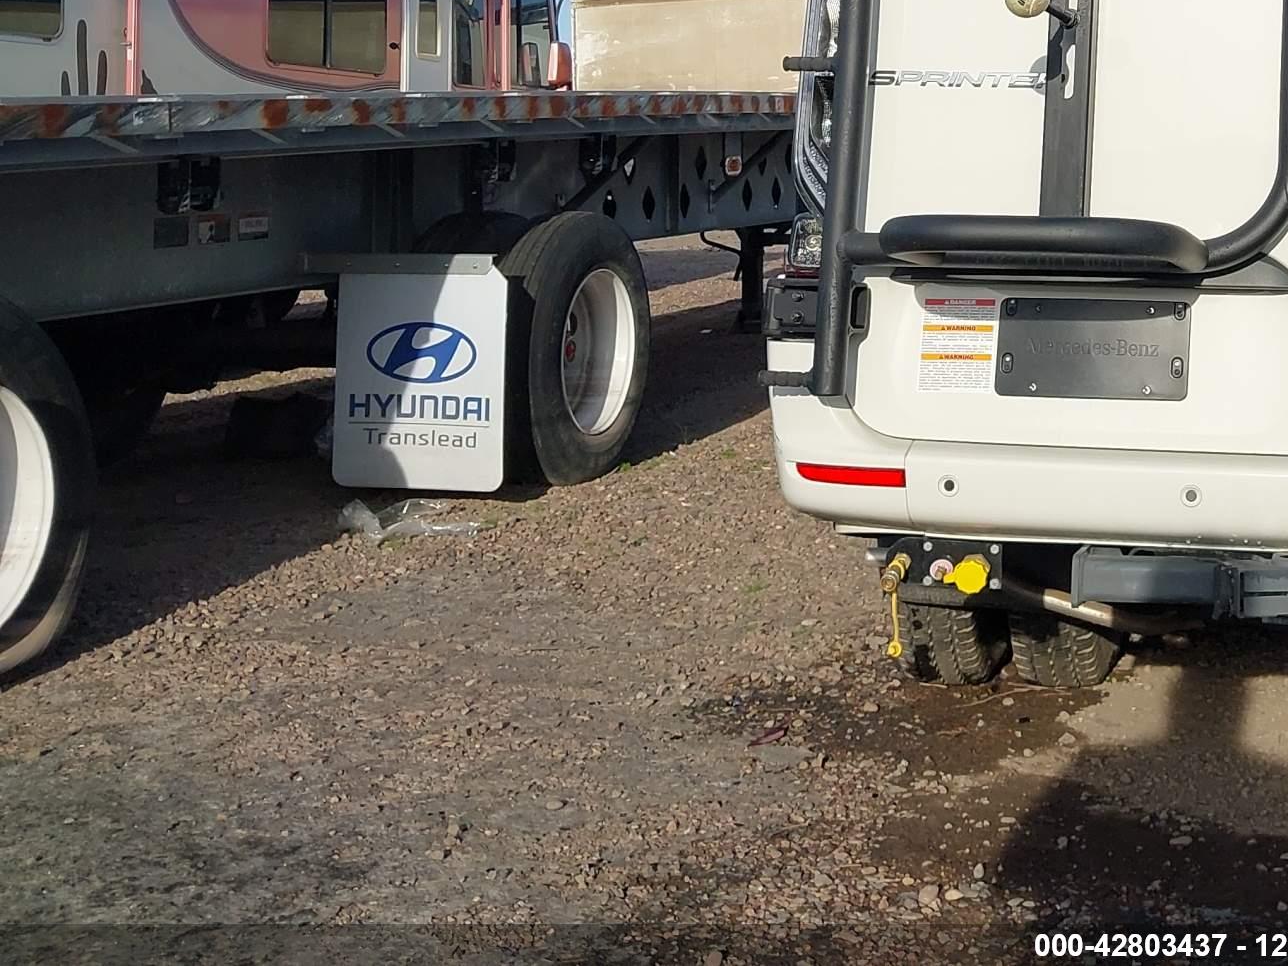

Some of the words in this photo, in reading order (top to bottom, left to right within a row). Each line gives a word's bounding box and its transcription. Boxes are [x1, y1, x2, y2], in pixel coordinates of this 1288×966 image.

[1027, 337, 1161, 357] Mercedes-Benz
[349, 393, 490, 422] HYUNDAI
[363, 428, 477, 449] Translead
